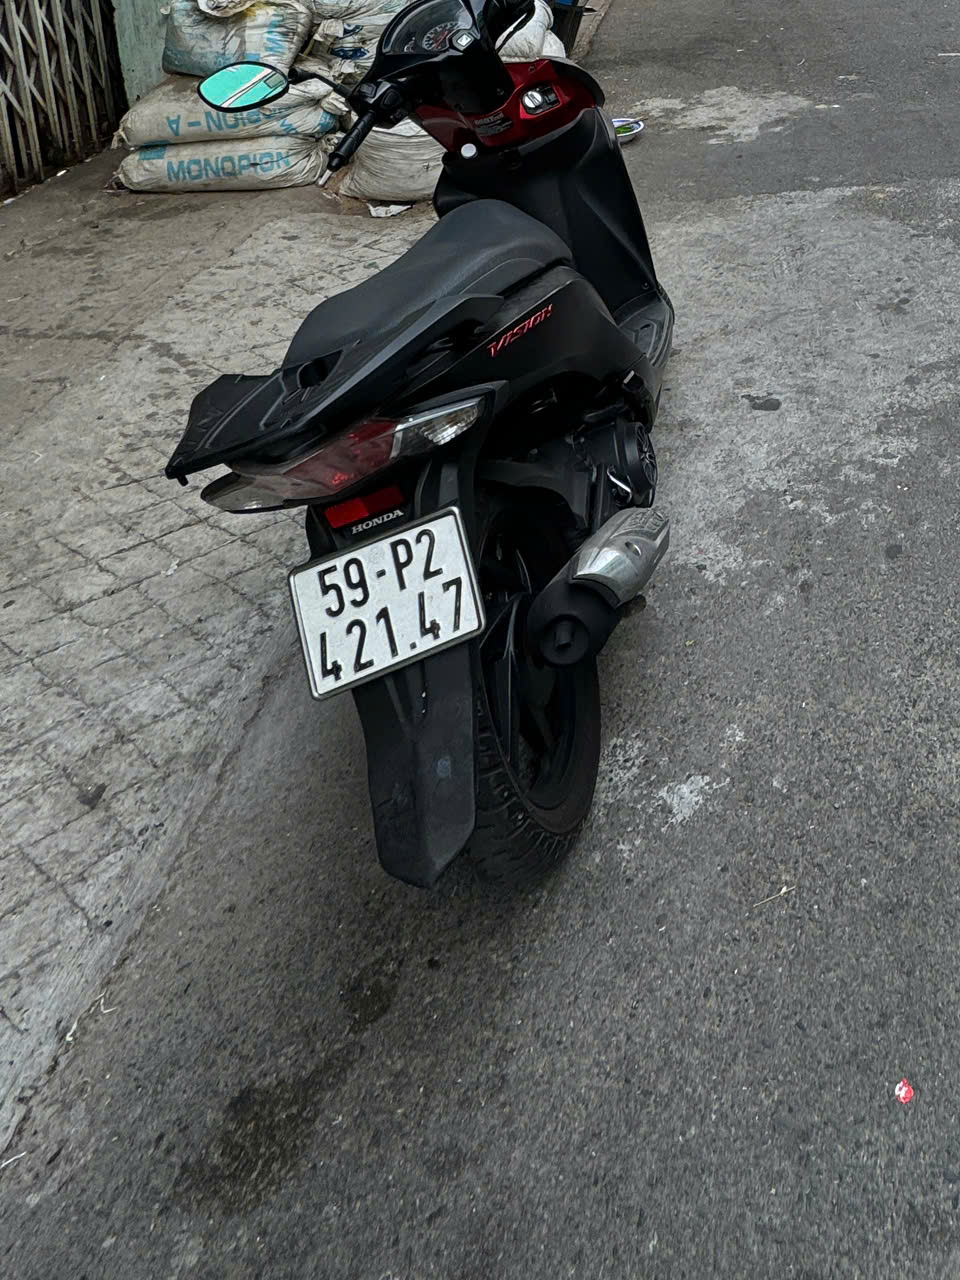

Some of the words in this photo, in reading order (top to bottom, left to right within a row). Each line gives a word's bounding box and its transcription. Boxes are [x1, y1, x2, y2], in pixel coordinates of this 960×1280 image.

[487, 303, 554, 358] VISION
[350, 508, 405, 535] HONDA
[317, 528, 443, 618] 59-P2
[319, 577, 464, 682] 421.47
